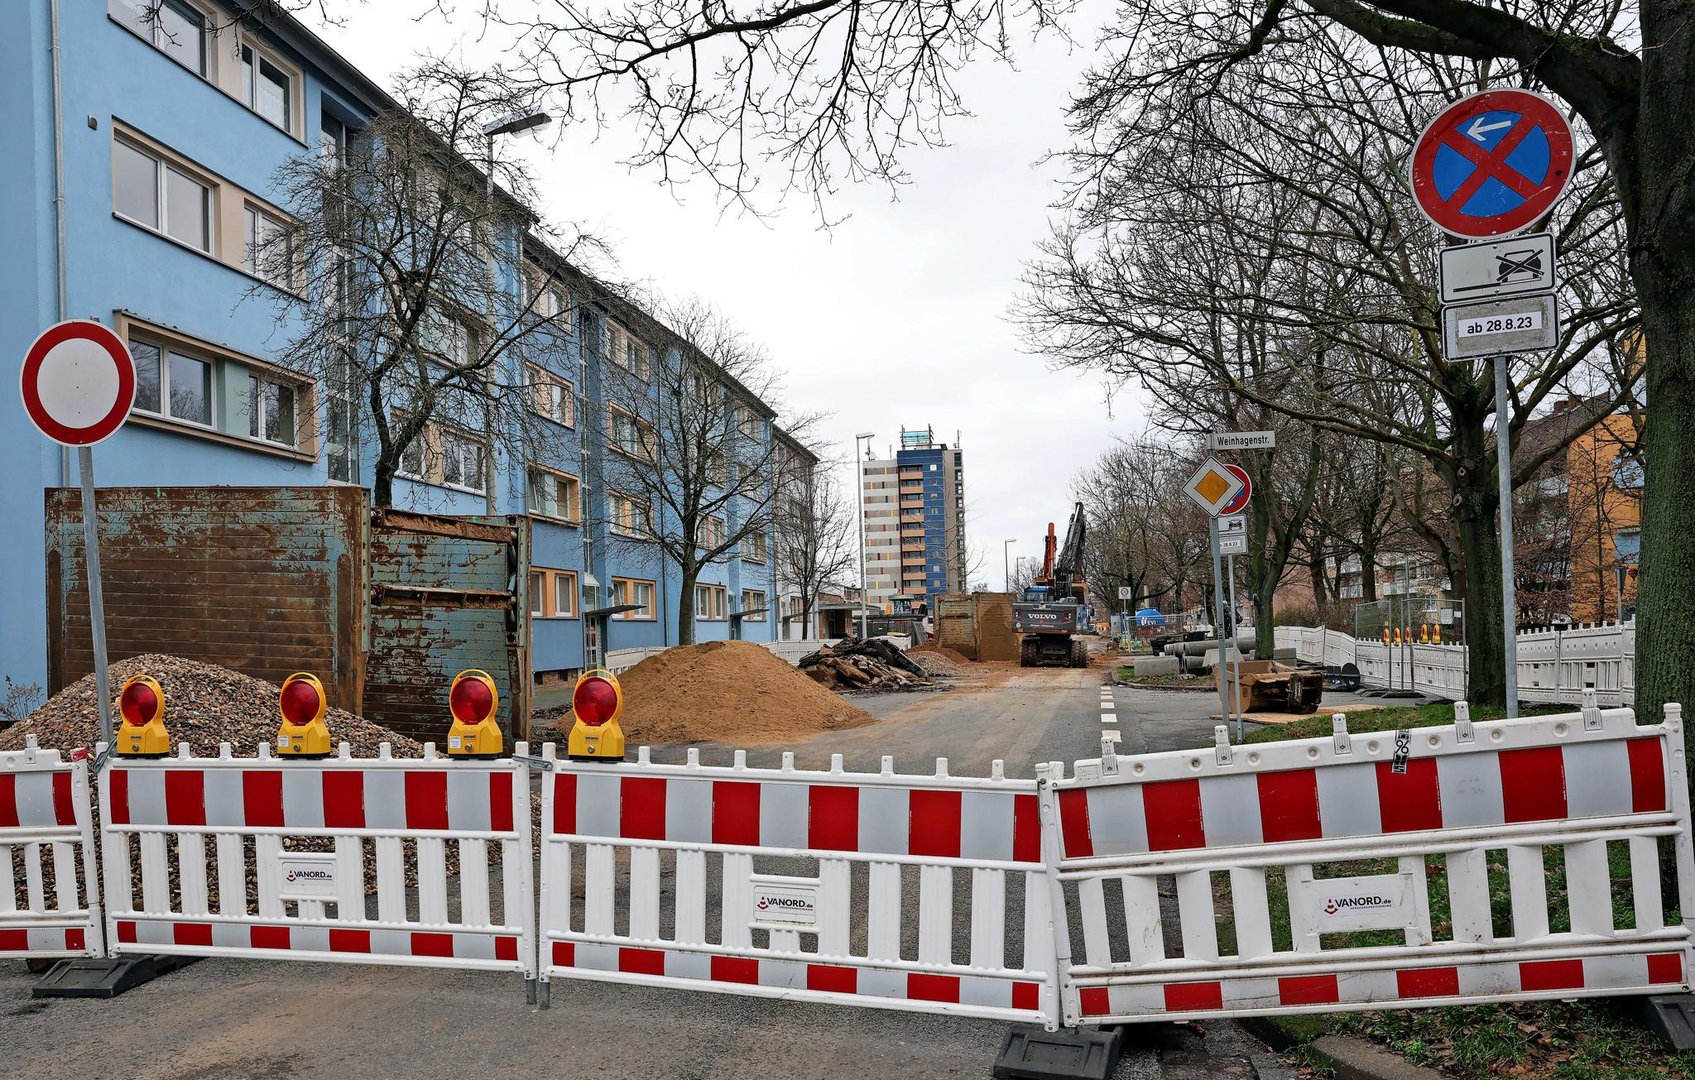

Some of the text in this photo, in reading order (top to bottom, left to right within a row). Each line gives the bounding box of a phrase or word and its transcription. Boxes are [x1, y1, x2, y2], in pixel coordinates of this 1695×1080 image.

[1467, 316, 1533, 334] ab 28.8.23
[1217, 435, 1270, 447] Weinhagenstr.
[1335, 896, 1392, 908] VANORD.de
